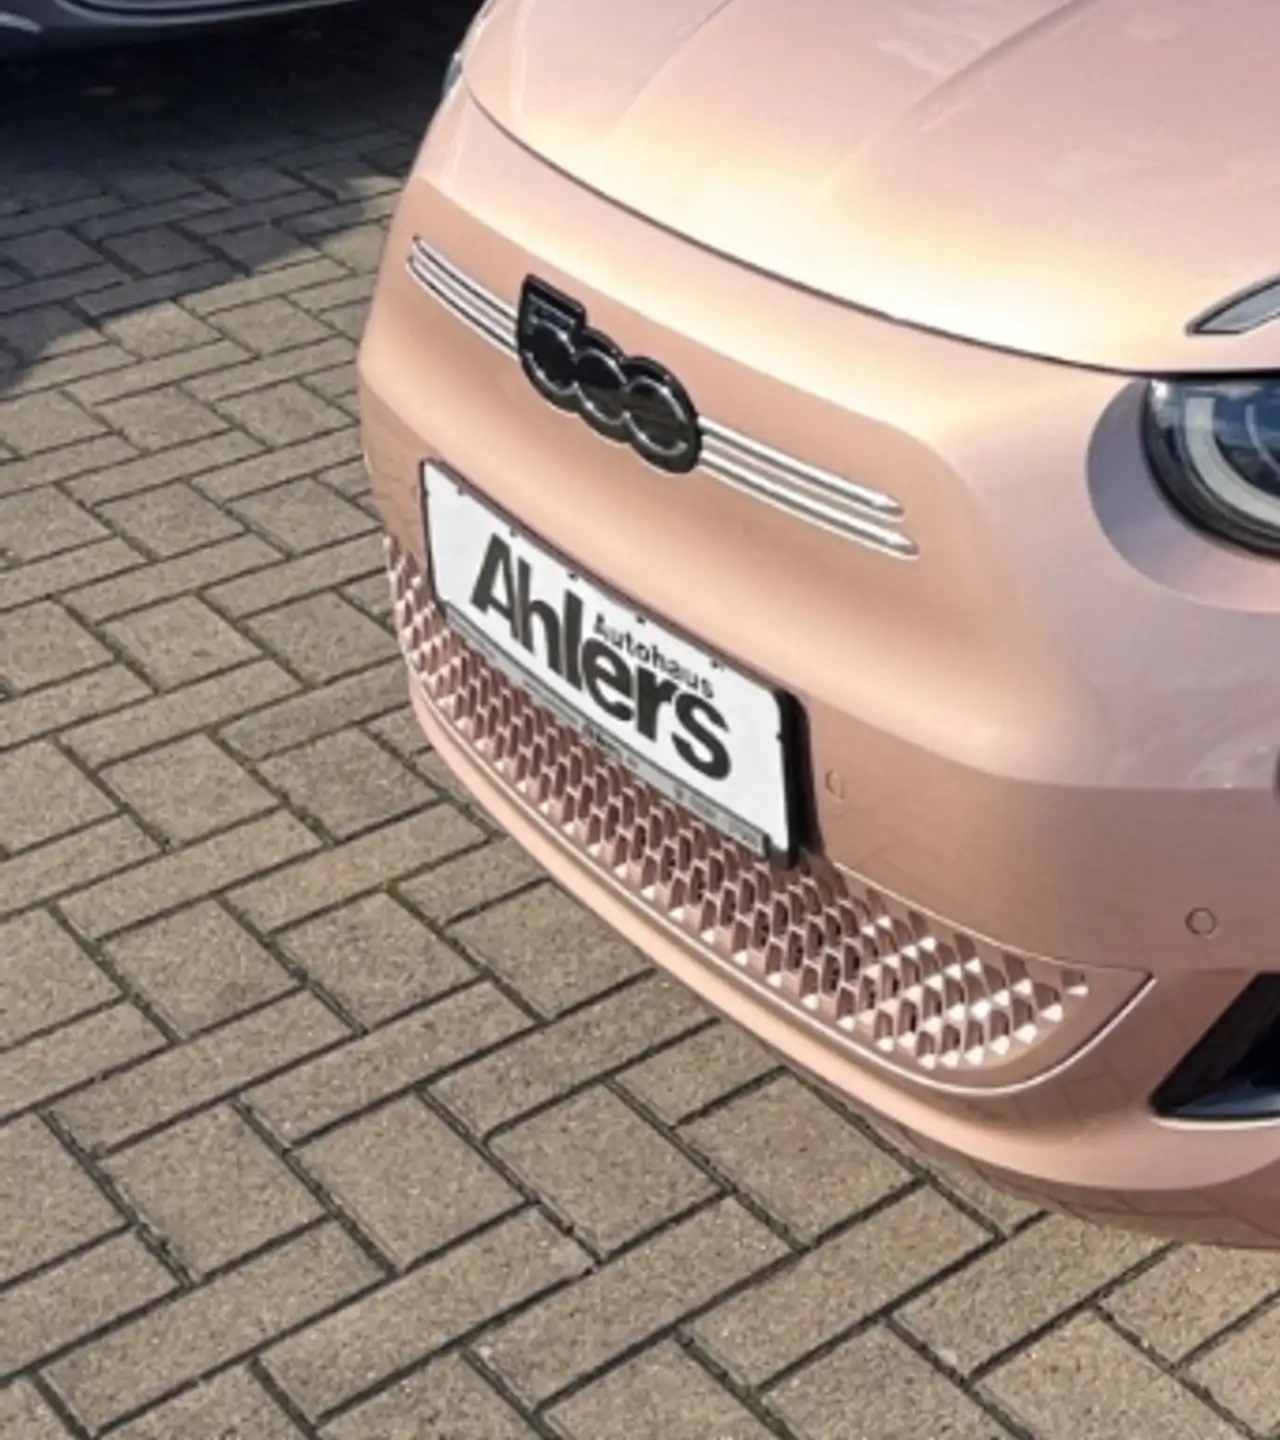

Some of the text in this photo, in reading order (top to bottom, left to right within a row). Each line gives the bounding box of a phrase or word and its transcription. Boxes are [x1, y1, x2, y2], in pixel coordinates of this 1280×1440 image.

[518, 273, 702, 474] 500
[470, 532, 732, 782] Ahlers
[593, 612, 714, 700] Autohaus
